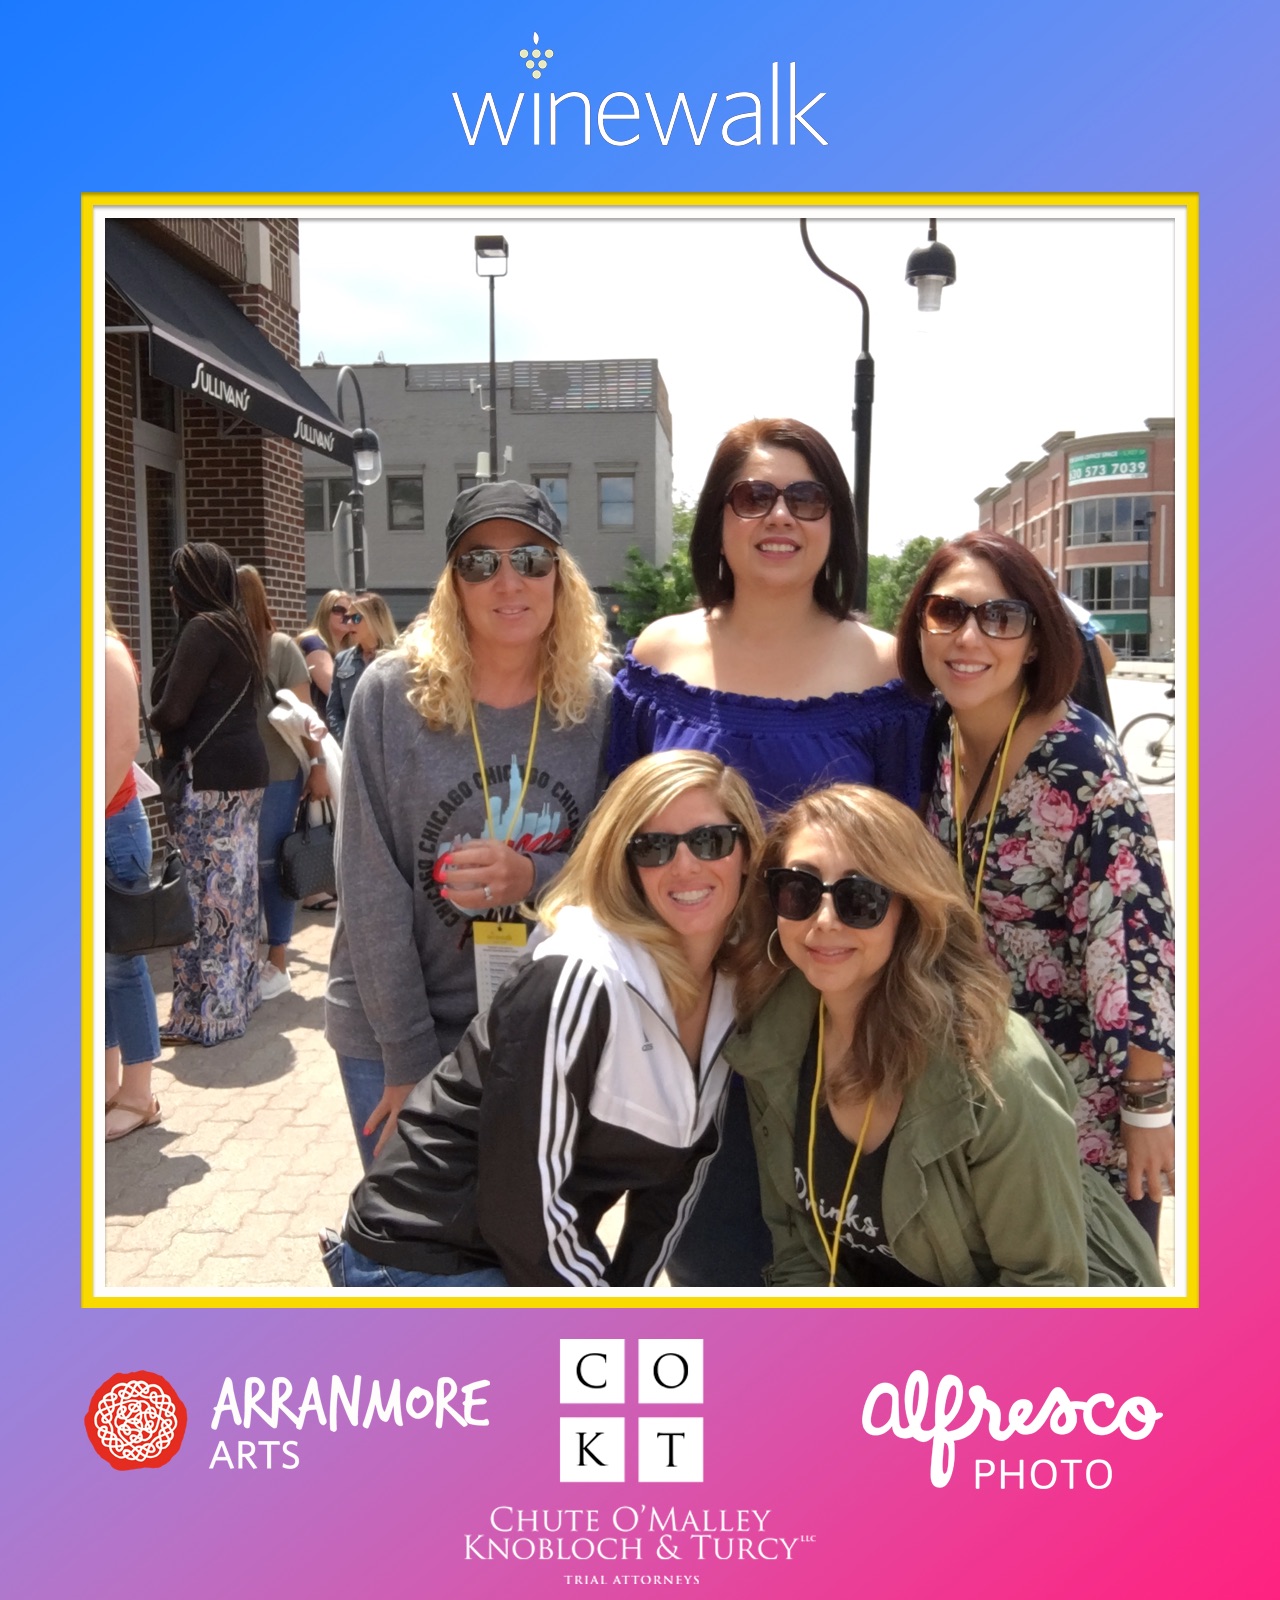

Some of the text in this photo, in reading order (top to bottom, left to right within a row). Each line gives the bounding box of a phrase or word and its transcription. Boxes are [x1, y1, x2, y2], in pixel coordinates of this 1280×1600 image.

[191, 362, 250, 411] SULLIVAN'S
[294, 415, 335, 452] SULLIVAN'S
[1085, 464, 1107, 478] 573
[1111, 461, 1146, 475] 7039
[418, 780, 474, 854] CHICAGO
[794, 1166, 880, 1238] Drinks
